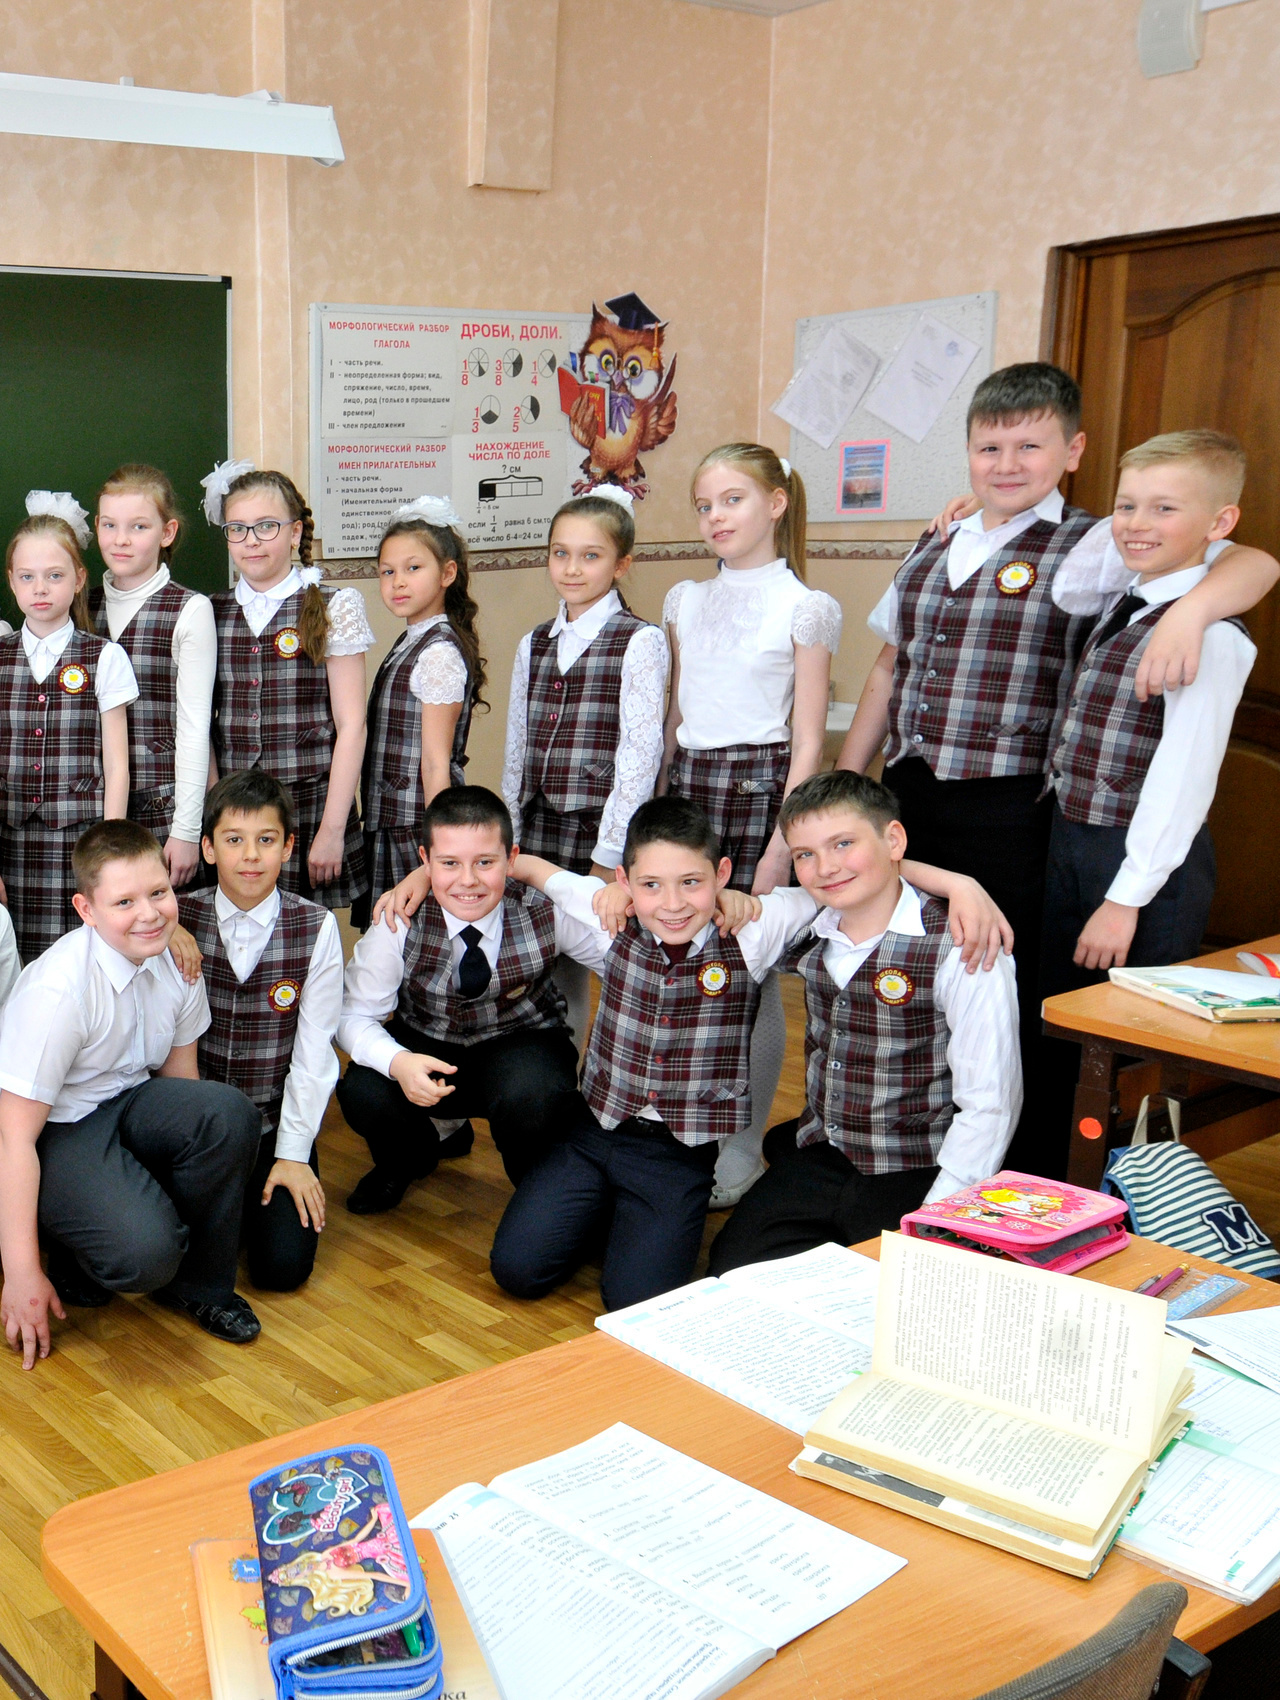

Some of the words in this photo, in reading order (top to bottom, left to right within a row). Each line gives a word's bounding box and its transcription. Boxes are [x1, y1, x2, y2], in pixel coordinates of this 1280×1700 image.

[329, 321, 415, 332] МОРФОЛОГИЧЕСКИЙ
[419, 324, 450, 332] РАЗБОР
[460, 323, 515, 341] ДРОБИ,
[519, 325, 562, 341] ДОЛИ.
[374, 340, 410, 348] ГЛАГОЛА
[343, 409, 375, 417] времени)
[328, 443, 411, 454] МОРФОЛОГИЧЕСКИЙ
[415, 444, 447, 452] РАЗБОР
[476, 441, 545, 451] НАХОЖДЕНИЕ
[468, 452, 504, 461] ЧИСЛА
[507, 451, 521, 460] ПО
[523, 450, 551, 460] ДОЛЕ
[338, 462, 361, 470] ИМЕН
[363, 460, 436, 469] ПРИЛАГАТЕЛЬНЫХ
[483, 535, 504, 543] число
[321, 1493, 350, 1531] Beauty
[337, 1477, 354, 1495] girl
